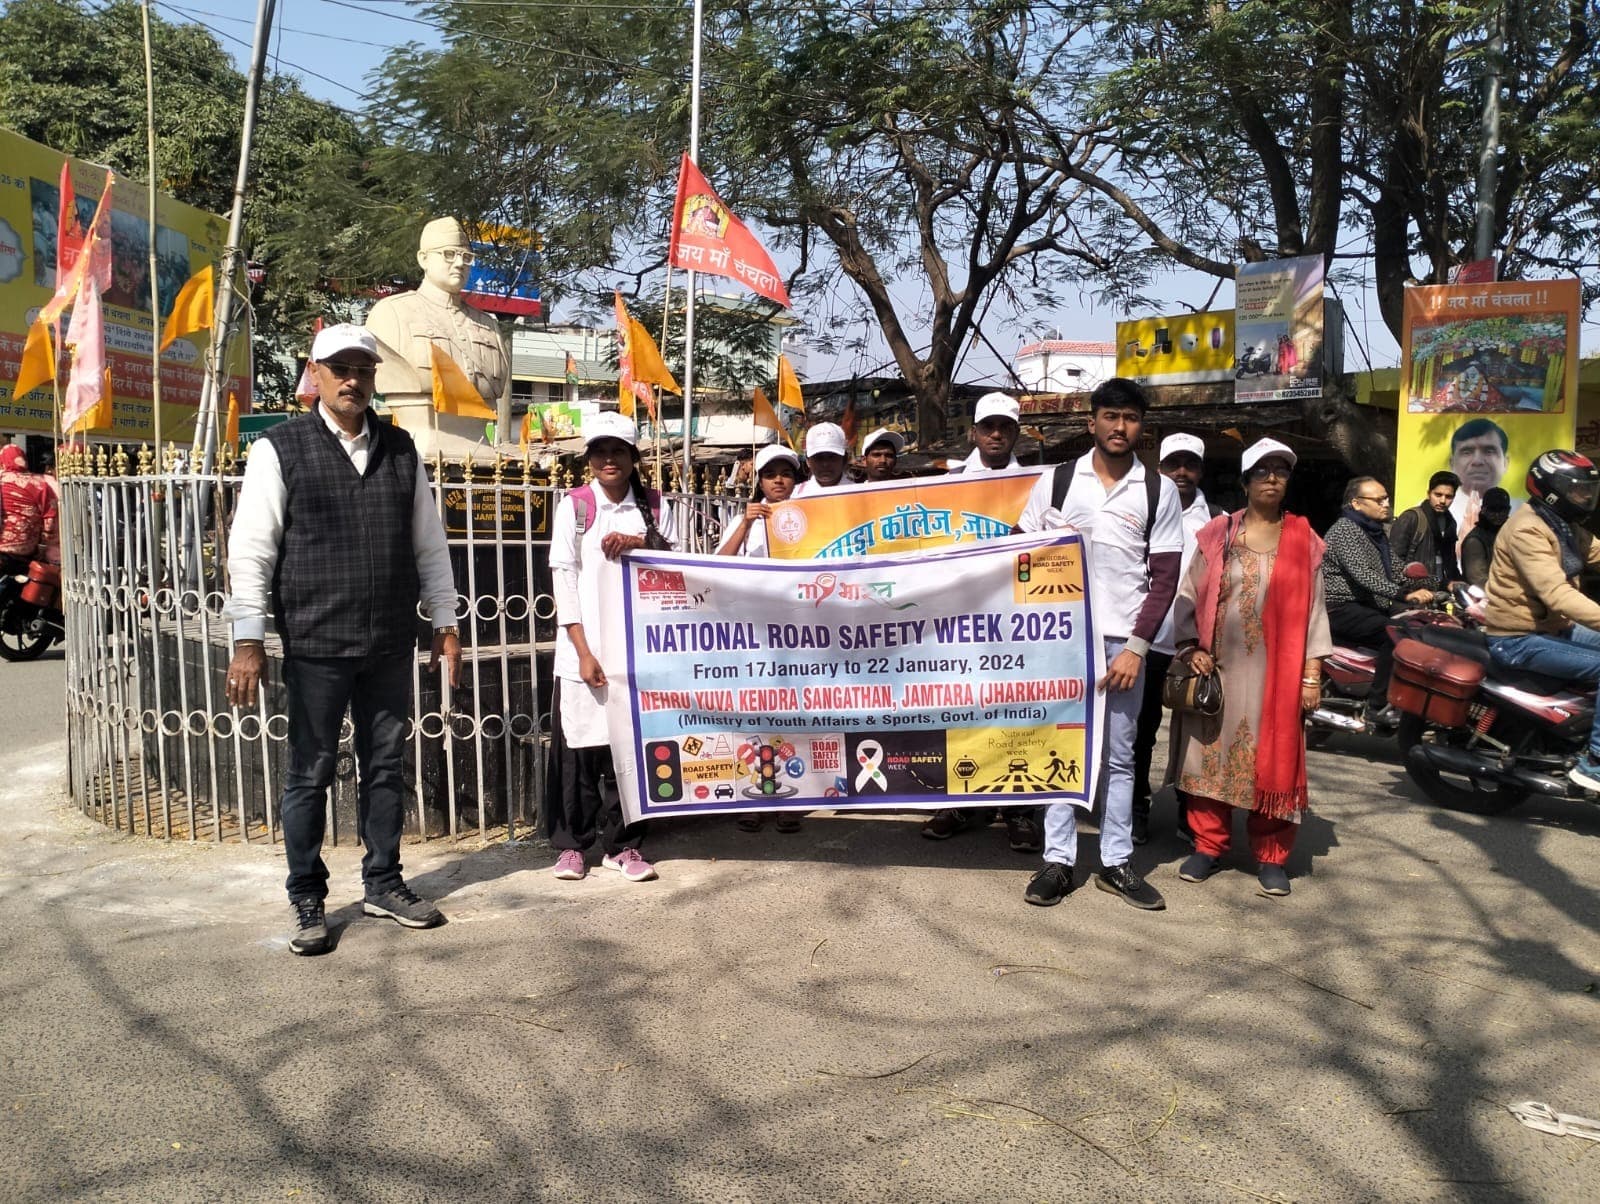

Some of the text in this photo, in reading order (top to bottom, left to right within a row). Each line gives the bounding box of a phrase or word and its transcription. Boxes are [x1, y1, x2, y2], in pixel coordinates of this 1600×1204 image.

[676, 243, 779, 293] जय माँ चंचला
[1447, 296, 1469, 309] जय
[1471, 291, 1489, 308] माँ
[1491, 290, 1533, 307] चंचला
[474, 513, 515, 521] JAMTRA
[880, 503, 952, 542] कॉलेज
[646, 611, 1073, 654] NATIONAL ROAD SAFETY WEEK 2025
[693, 664, 739, 680] From
[844, 660, 861, 675] to
[867, 658, 890, 674] 22
[895, 656, 972, 676] January,
[979, 655, 1025, 671] 2024
[640, 678, 1085, 714] NEHRU YUVA KENDRA SANGATHAN, JAMTARA (JHARKHAND)
[678, 706, 1048, 729] (Ministry of Youth Affairs & Sports, Govt. of India)
[812, 741, 838, 751] ROAD
[988, 737, 1047, 749] Road safety
[812, 751, 838, 760] SAFETY
[1006, 748, 1029, 756] week
[813, 759, 839, 770] RULES
[887, 756, 943, 764] ROAD SAFETY
[683, 763, 733, 774] ROAD SAFETY
[696, 772, 719, 780] WEEK
